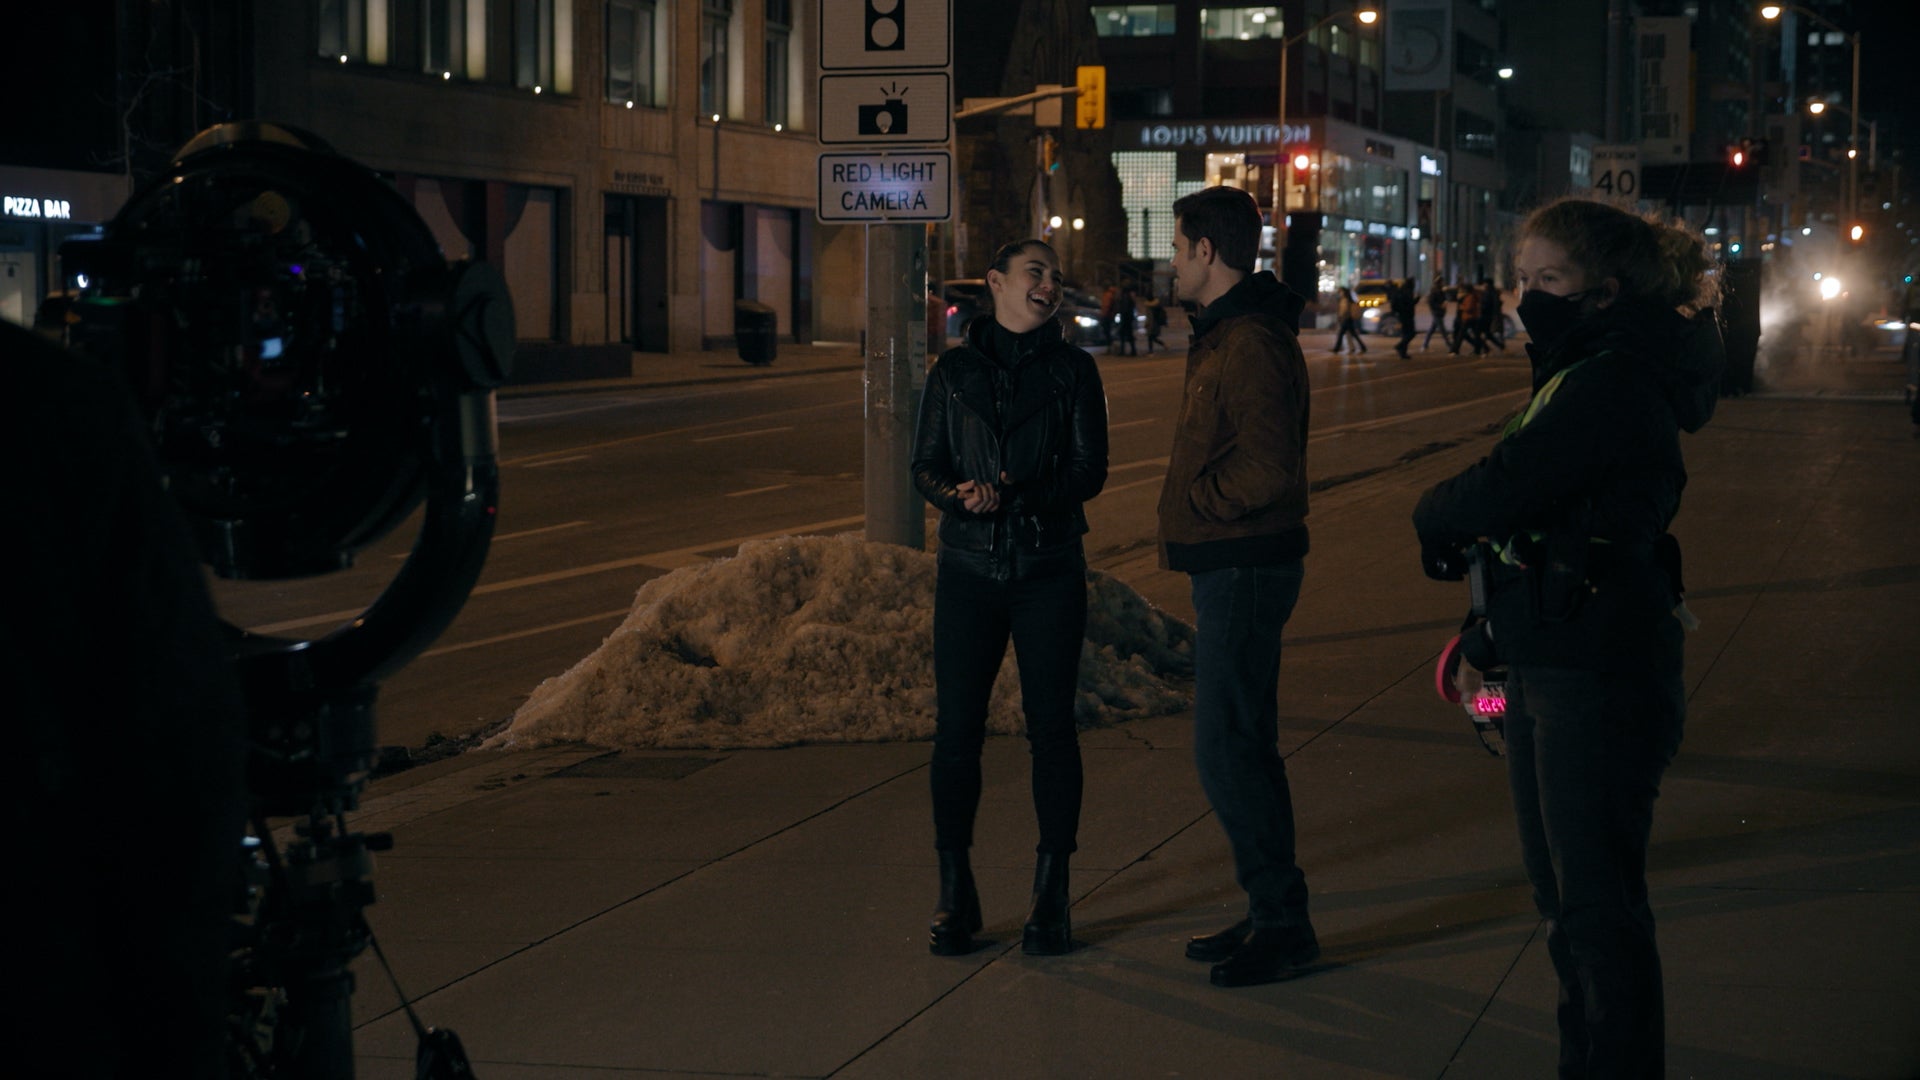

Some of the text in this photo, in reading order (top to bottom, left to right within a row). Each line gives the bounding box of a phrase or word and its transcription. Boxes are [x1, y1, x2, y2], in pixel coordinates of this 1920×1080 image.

[1212, 124, 1311, 146] VUITTON
[833, 162, 937, 183] RED LIGHT
[1595, 169, 1635, 195] 40
[3, 195, 71, 220] PIZZA BAR
[841, 190, 928, 210] CAMERA
